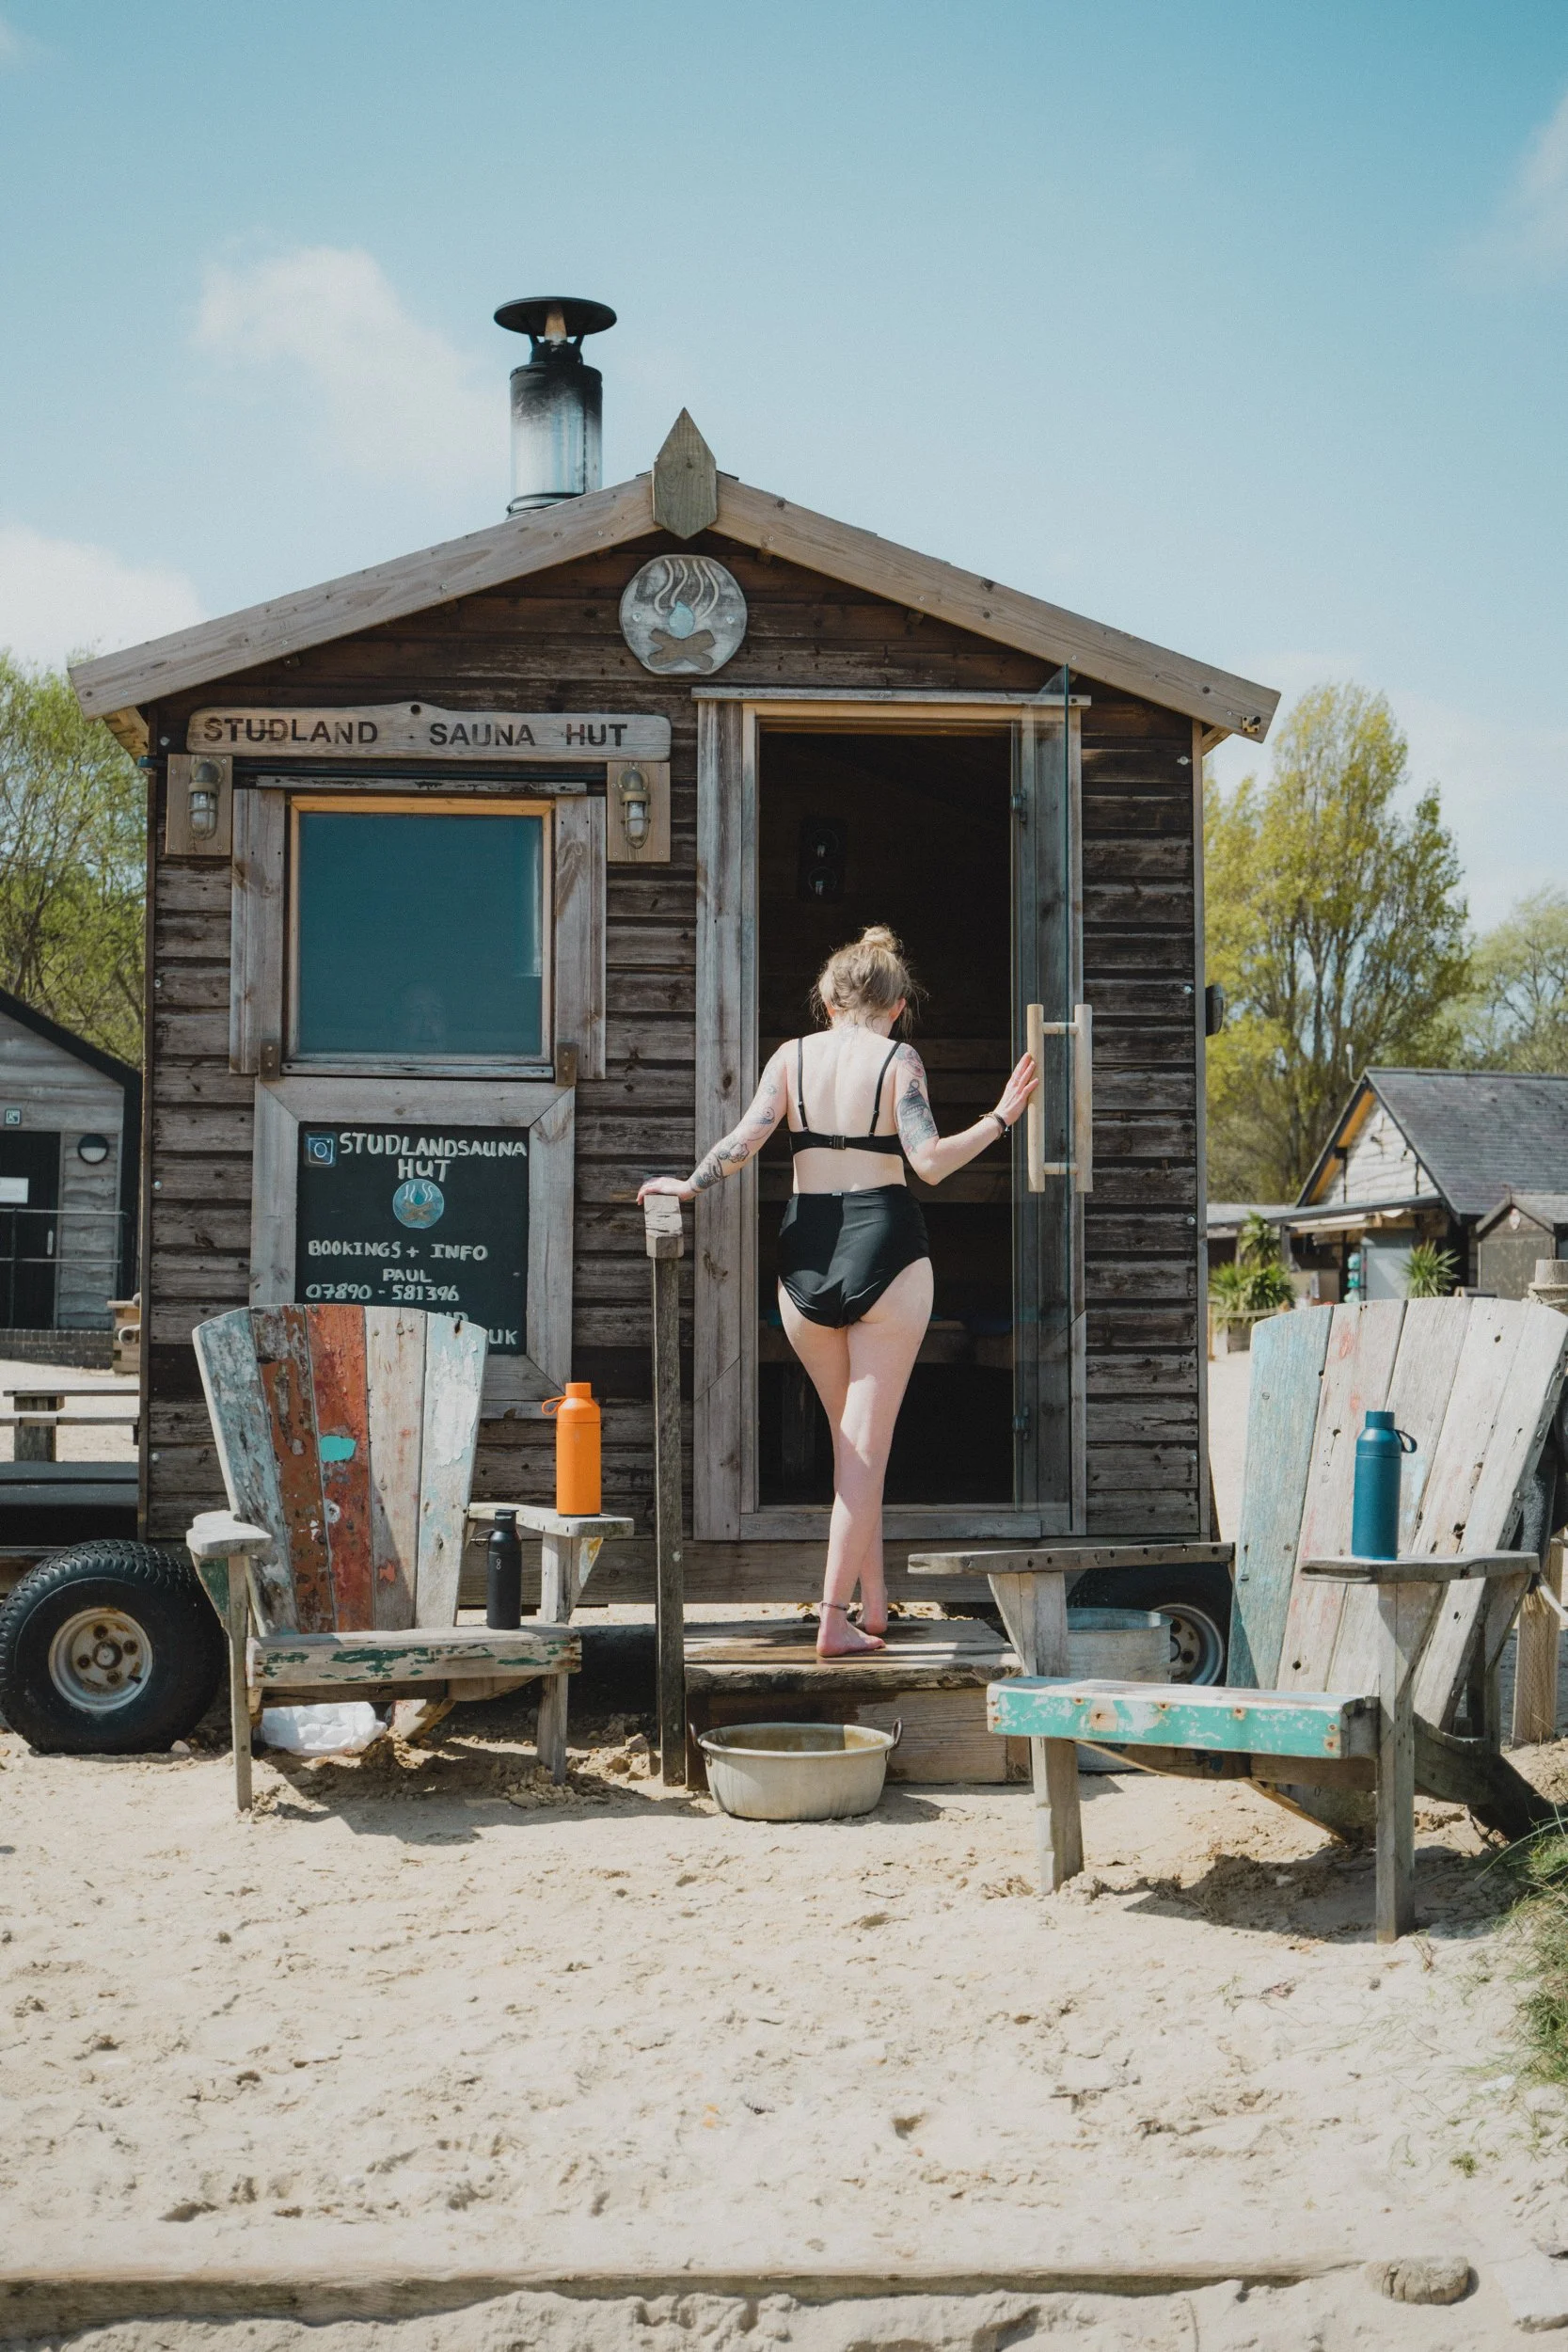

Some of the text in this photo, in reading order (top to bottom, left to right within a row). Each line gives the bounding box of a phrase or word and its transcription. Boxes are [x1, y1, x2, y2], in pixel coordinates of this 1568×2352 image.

[204, 717, 627, 746] STUDLAND SAUNA HUT
[340, 1132, 527, 1157] STUDLANDSAUNA
[308, 1240, 401, 1258] BOOKINGS
[430, 1244, 488, 1262] INFO
[382, 1268, 433, 1283] PAUL
[306, 1283, 372, 1299] 07890
[391, 1285, 459, 1301] 581396
